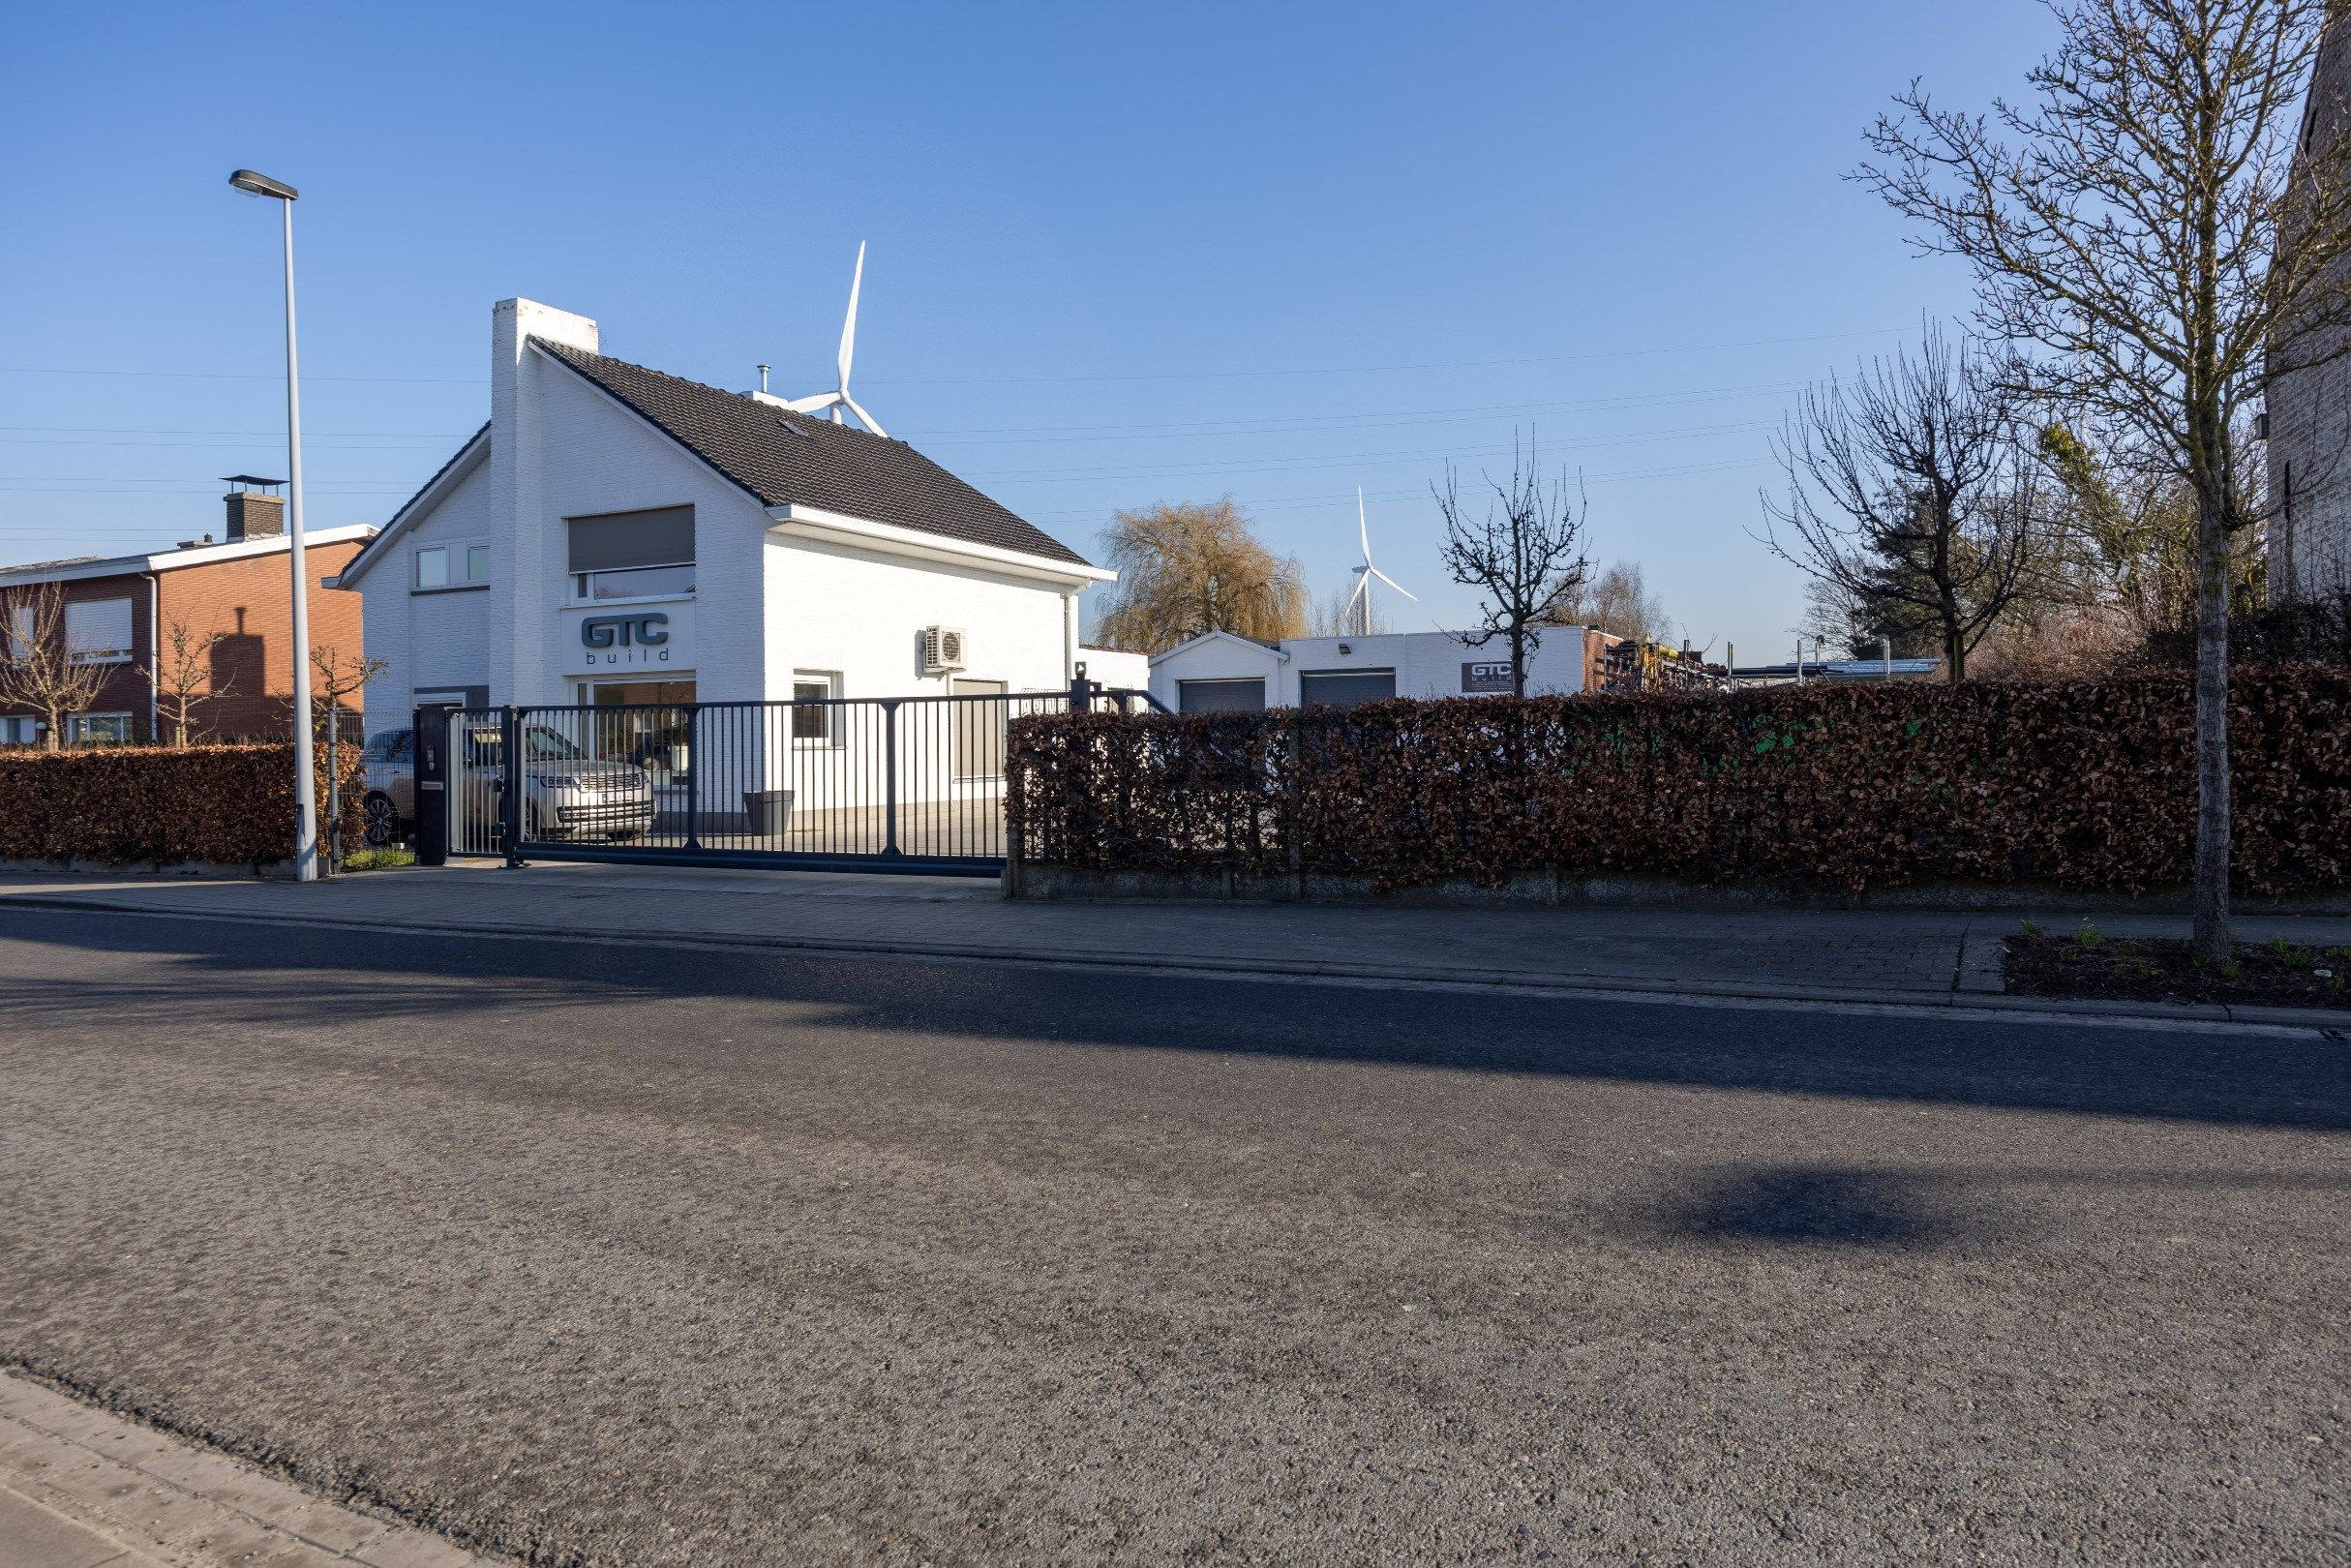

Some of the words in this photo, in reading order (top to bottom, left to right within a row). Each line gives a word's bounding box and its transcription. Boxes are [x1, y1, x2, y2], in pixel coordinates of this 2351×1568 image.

[582, 612, 669, 648] GTC
[587, 648, 669, 665] build
[1471, 663, 1512, 676] GTC
